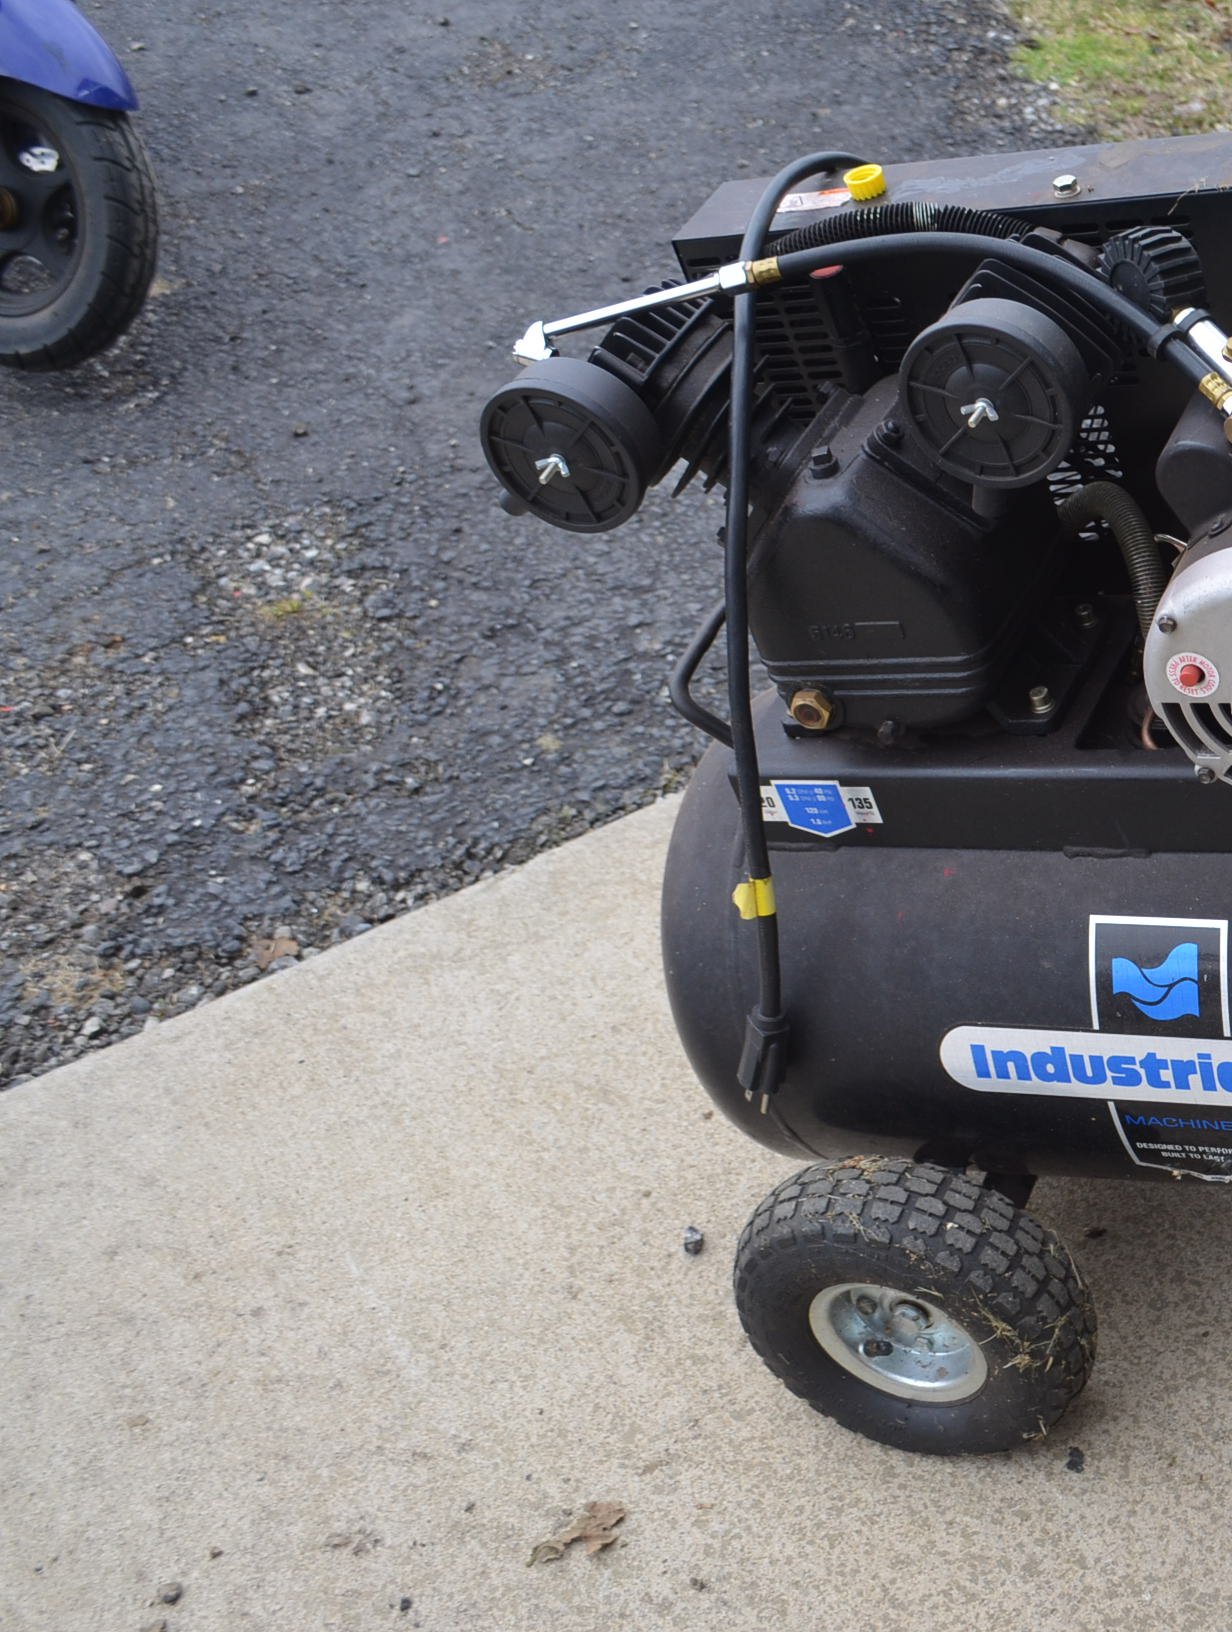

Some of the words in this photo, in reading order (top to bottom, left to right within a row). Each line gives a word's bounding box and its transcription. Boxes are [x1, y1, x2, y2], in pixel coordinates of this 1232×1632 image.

[848, 797, 873, 810] 135
[1136, 1142, 1183, 1151] DESIGNED
[1188, 1152, 1202, 1160] TO
[1203, 1154, 1225, 1163] LAST
